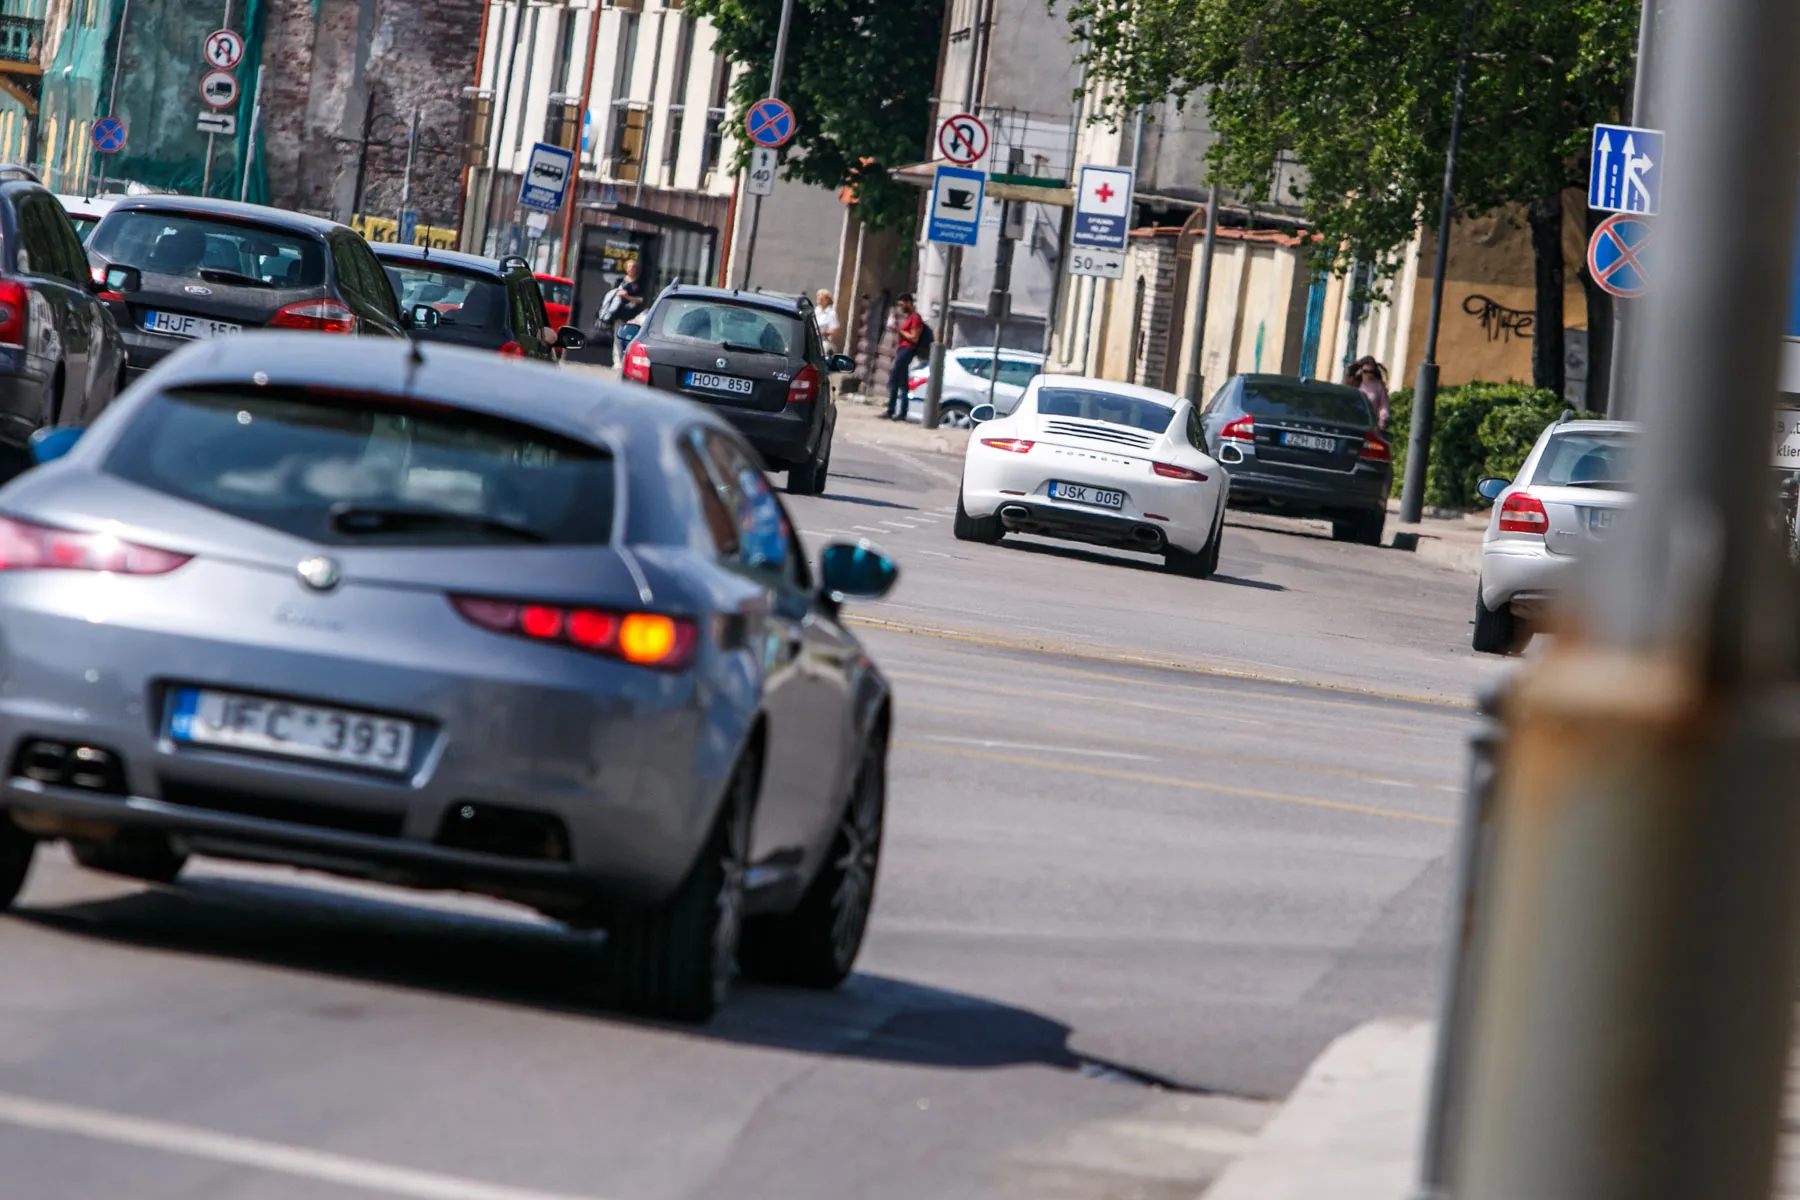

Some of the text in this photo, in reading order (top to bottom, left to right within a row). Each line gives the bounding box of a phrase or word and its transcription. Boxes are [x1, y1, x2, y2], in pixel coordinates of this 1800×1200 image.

[752, 169, 770, 182] 40
[1073, 255, 1093, 270] 50
[157, 314, 196, 333] HJF
[692, 373, 751, 392] HOO 859
[1058, 485, 1120, 506] JSK 005
[204, 697, 401, 759] JFC 393
